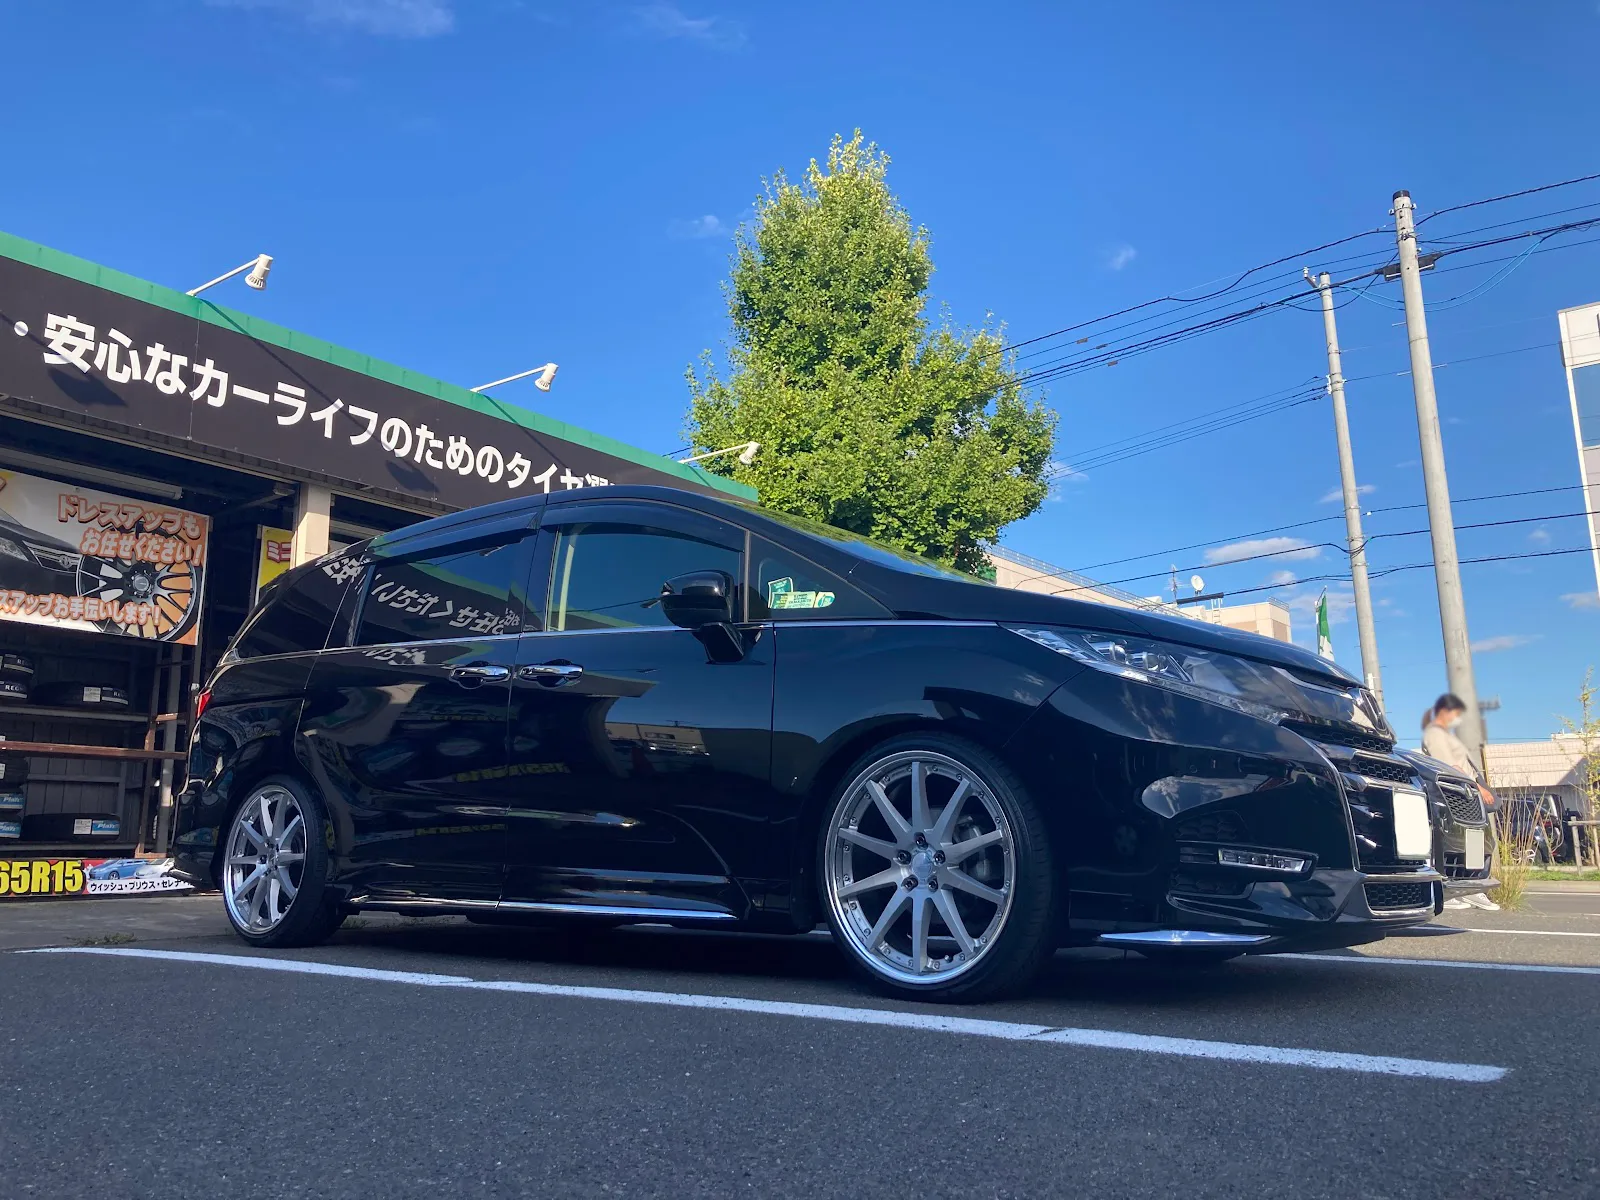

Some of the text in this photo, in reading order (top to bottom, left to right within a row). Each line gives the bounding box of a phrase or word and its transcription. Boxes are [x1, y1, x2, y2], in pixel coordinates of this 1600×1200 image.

[58, 493, 201, 539] ドレスアップも
[80, 527, 203, 566] お任せください！
